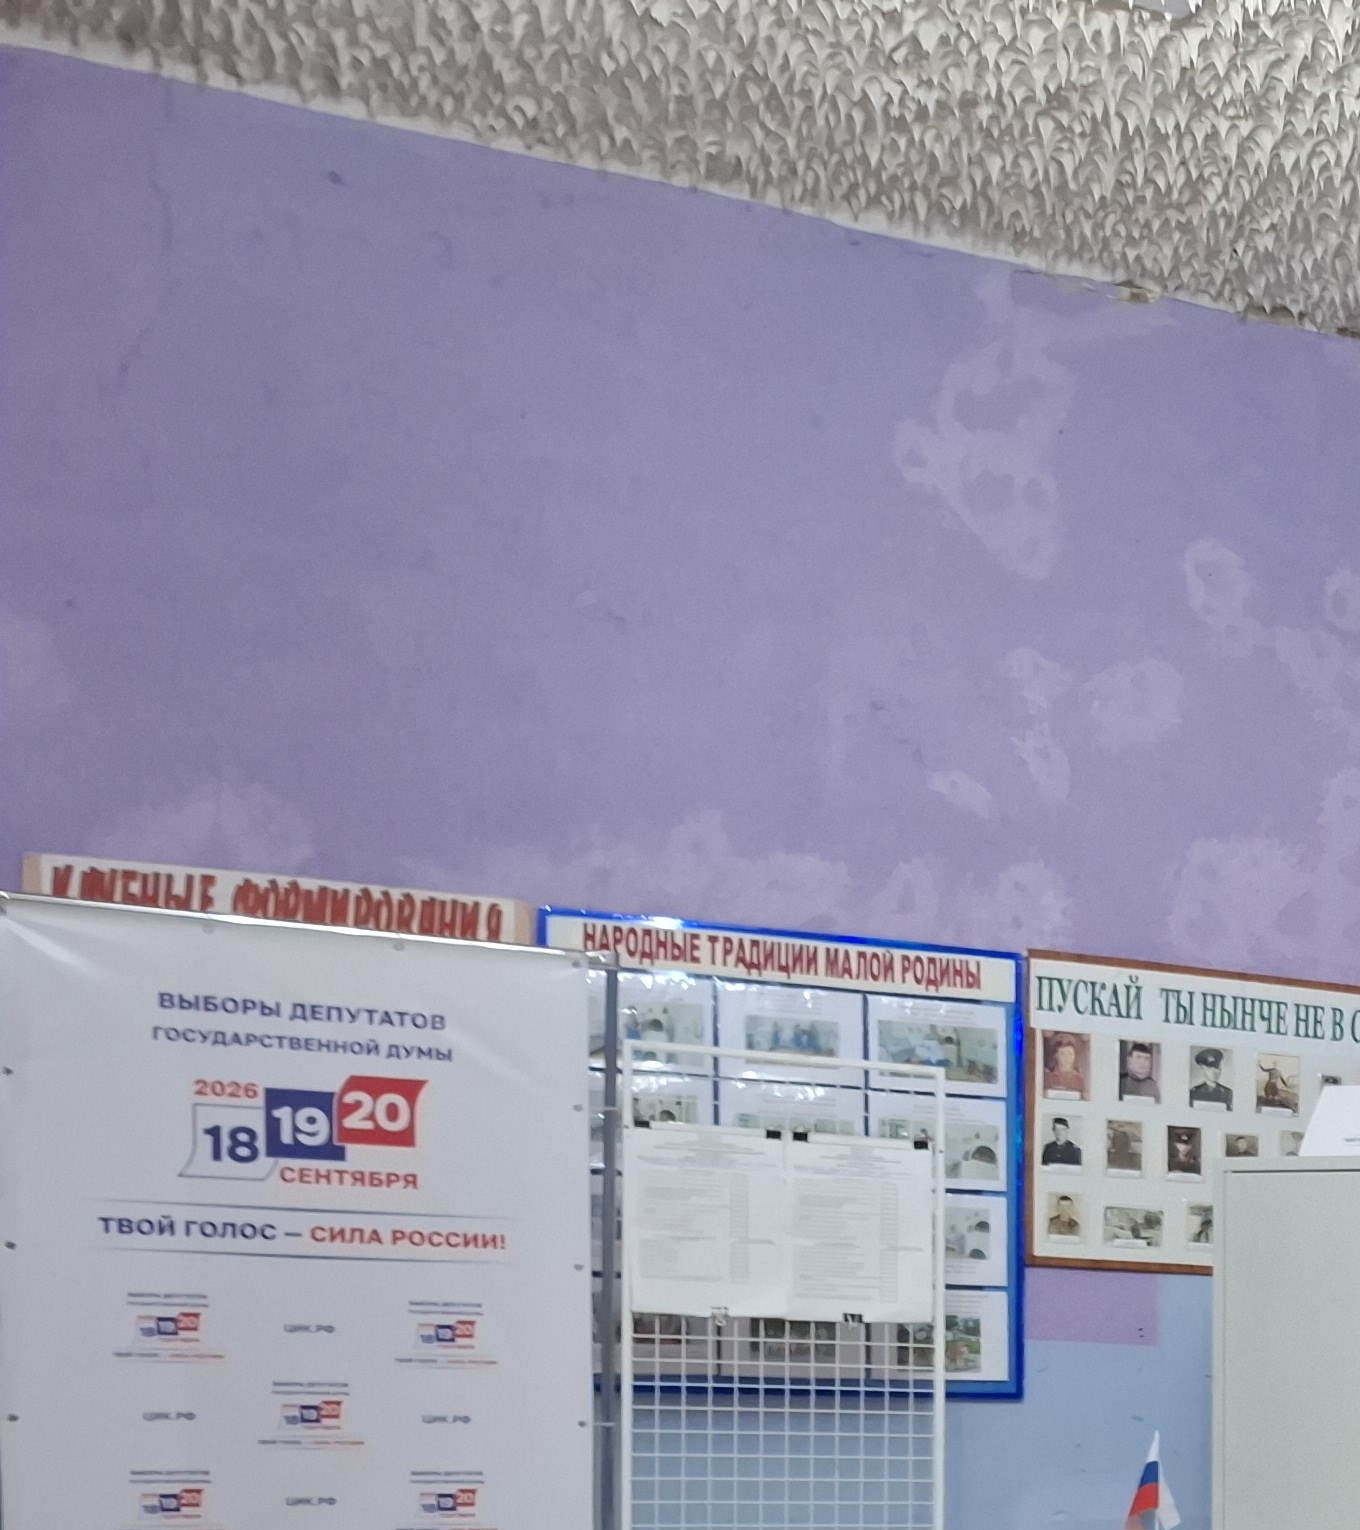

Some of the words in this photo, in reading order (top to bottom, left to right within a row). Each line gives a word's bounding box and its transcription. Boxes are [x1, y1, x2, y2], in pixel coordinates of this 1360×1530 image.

[582, 922, 701, 964] НАРОДНЫЕ
[708, 935, 819, 976] ТРАДИЦИИ
[824, 946, 895, 984] МАЛОЙ
[901, 953, 982, 992] РОДИНЫ
[157, 991, 281, 1018] ВЫБОРЫ
[288, 1002, 446, 1031] ДЕПУТАТОВ
[1035, 975, 1143, 1020] ПУСКАЙ
[1160, 987, 1195, 1026] ТЫ
[1201, 991, 1288, 1036] НЫНЧЕ
[1293, 1003, 1325, 1040] НЕ
[1330, 1007, 1345, 1042] В
[152, 1025, 380, 1056] ГОСУДАРСТВЕННОЙ
[385, 1042, 454, 1062] ДУМЫ
[193, 1079, 260, 1099] 2026
[203, 1124, 259, 1163] 18
[271, 1105, 331, 1146] 19
[341, 1090, 411, 1132] 20
[279, 1166, 419, 1190] СЕНТЯБРЯ
[98, 1215, 176, 1236] ТВОЙ
[184, 1219, 277, 1241] ГОЛОС
[310, 1225, 383, 1245] СИЛА
[390, 1229, 507, 1250] РОССИИ!
